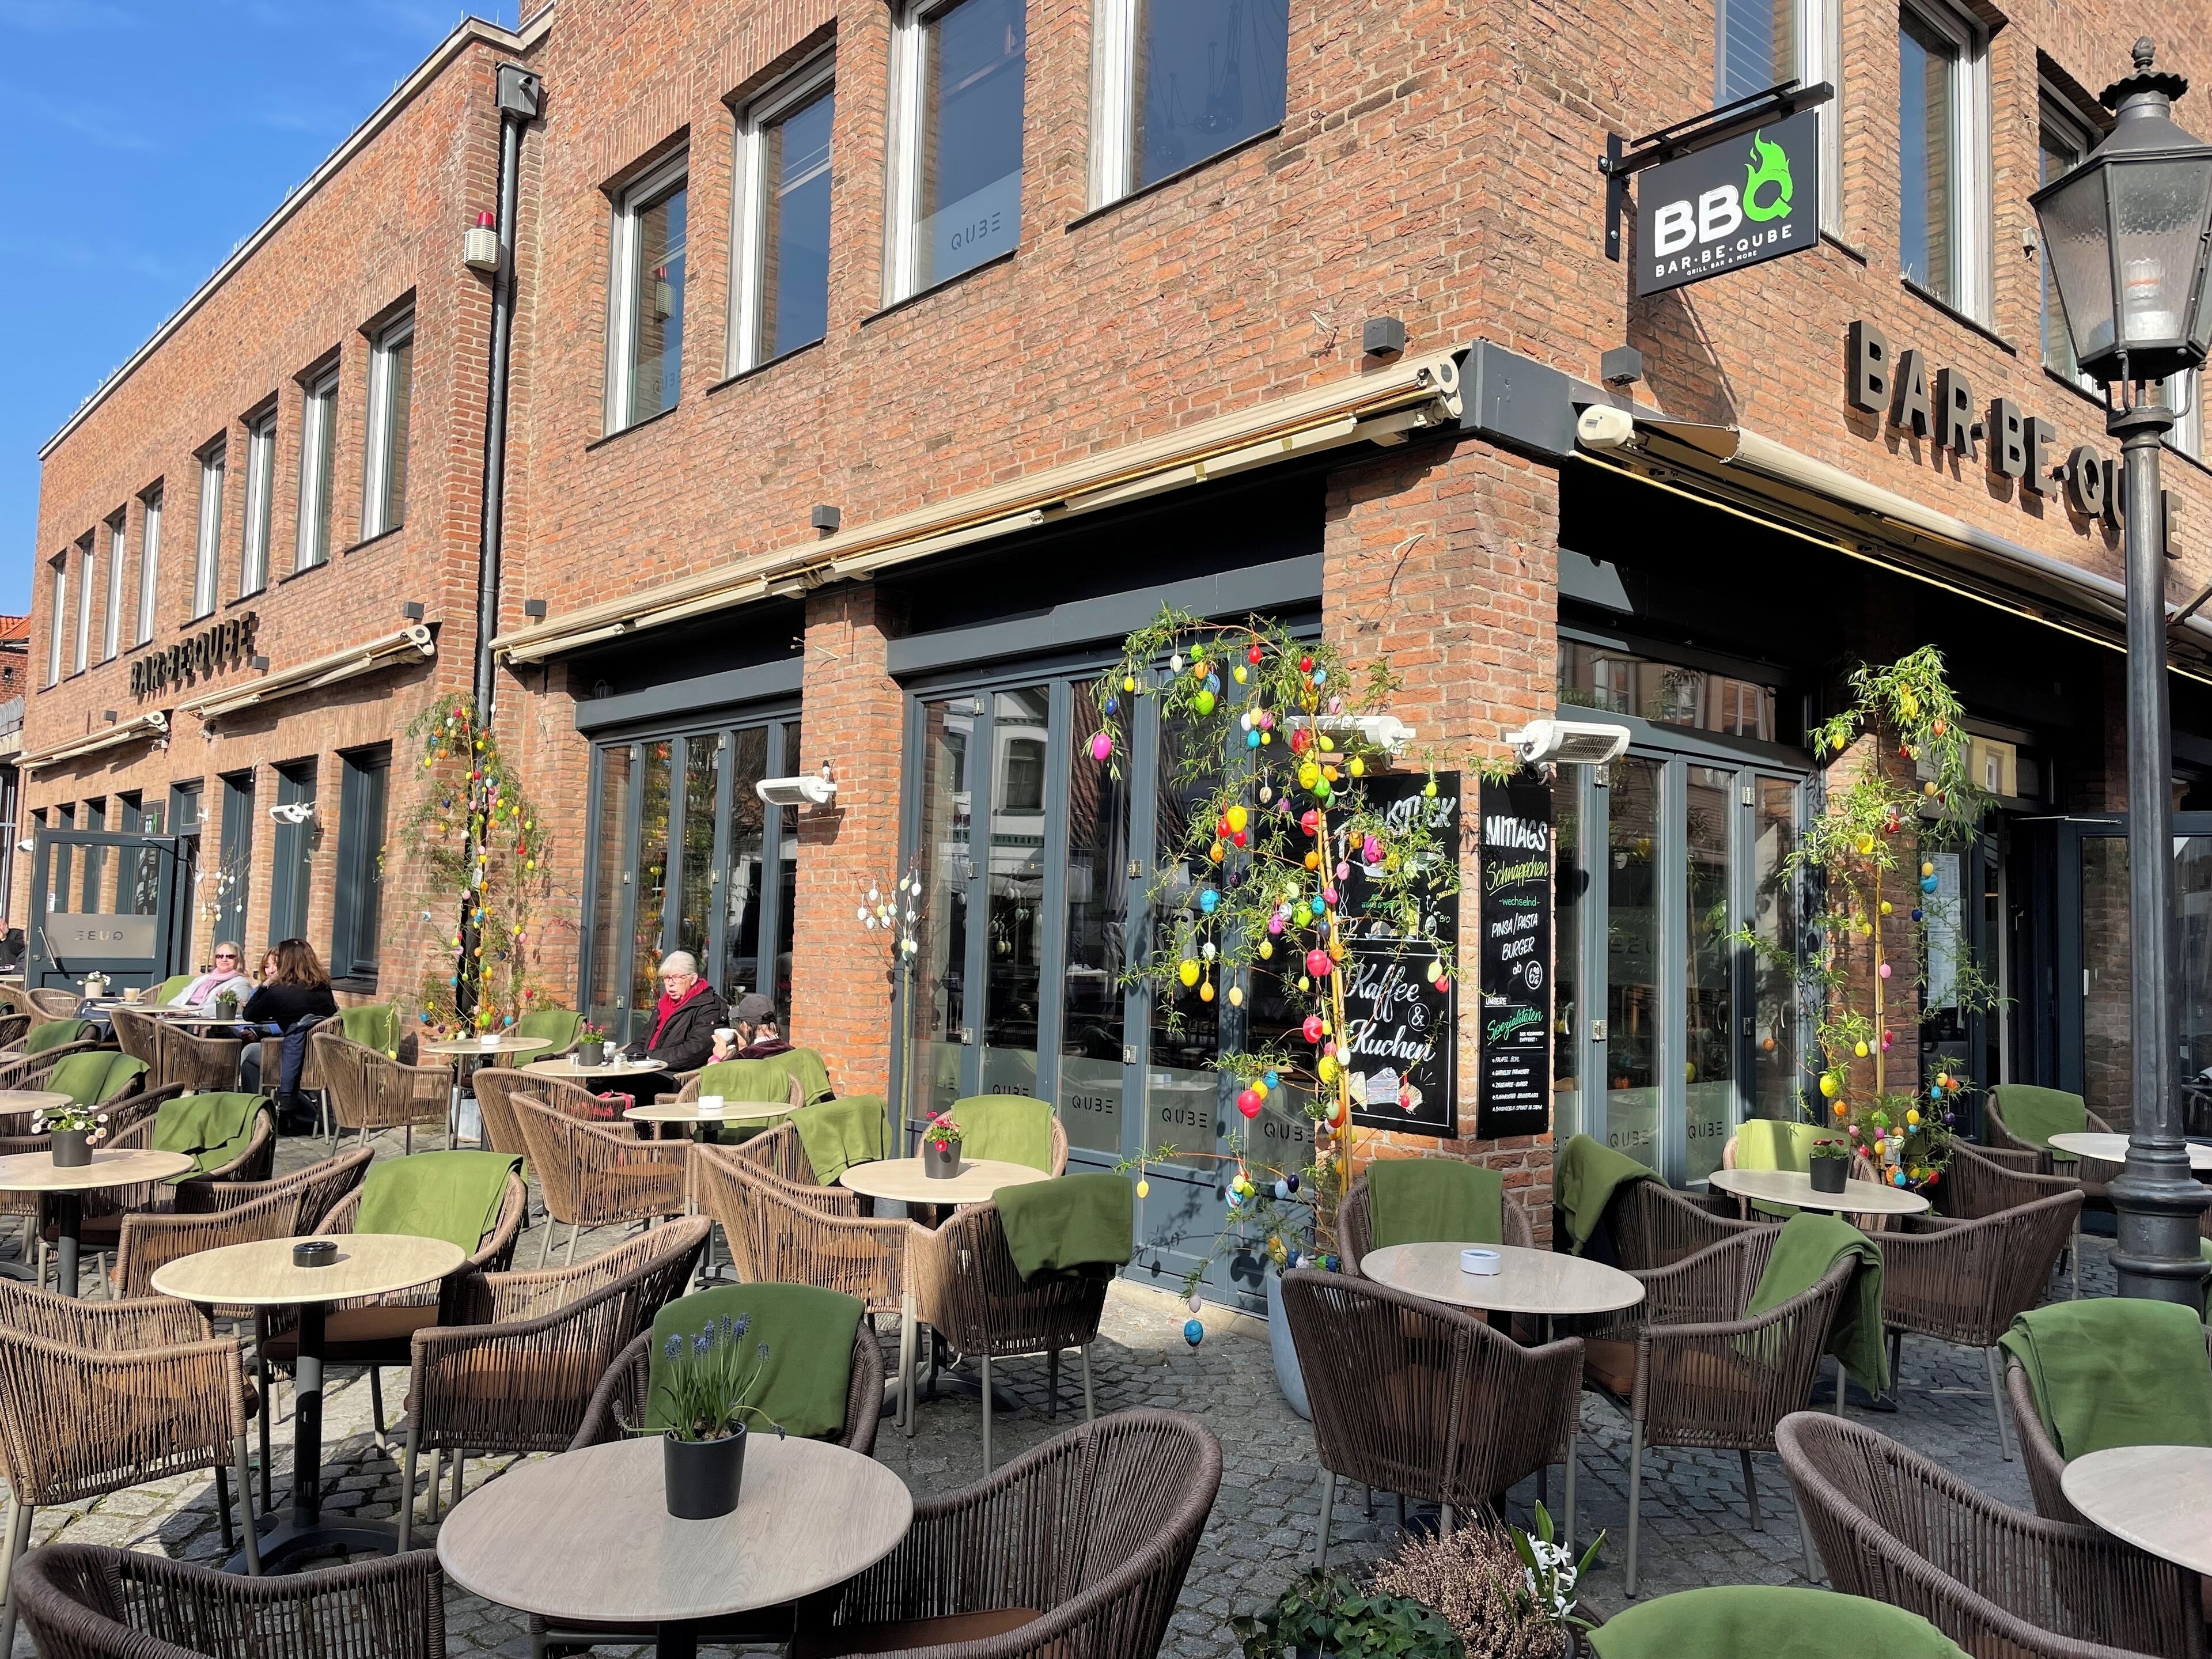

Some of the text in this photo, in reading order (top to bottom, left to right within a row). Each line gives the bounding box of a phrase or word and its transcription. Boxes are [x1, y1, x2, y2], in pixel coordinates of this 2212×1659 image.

[1655, 129, 1793, 258] BBQ
[951, 211, 1001, 251] QUBE
[1687, 266, 1707, 275] GRILL
[1710, 260, 1725, 268] BAR
[1736, 250, 1758, 261] MORE
[1486, 815, 1548, 851] MITTAGS
[1439, 915, 1450, 923] BIO
[1502, 936, 1535, 961] BURGER
[1512, 961, 1522, 975] ab
[1345, 963, 1419, 1022] Kaffee
[1486, 997, 1508, 1005] UNSERE
[1411, 1006, 1425, 1027] &
[1349, 1019, 1436, 1062] Kuchen
[1072, 1095, 1113, 1114] QUBE
[1162, 1108, 1208, 1128] QUBE
[1264, 1122, 1315, 1144] QUBE
[1609, 1130, 1649, 1148] QUBE
[1688, 1121, 1723, 1139] QUBE
